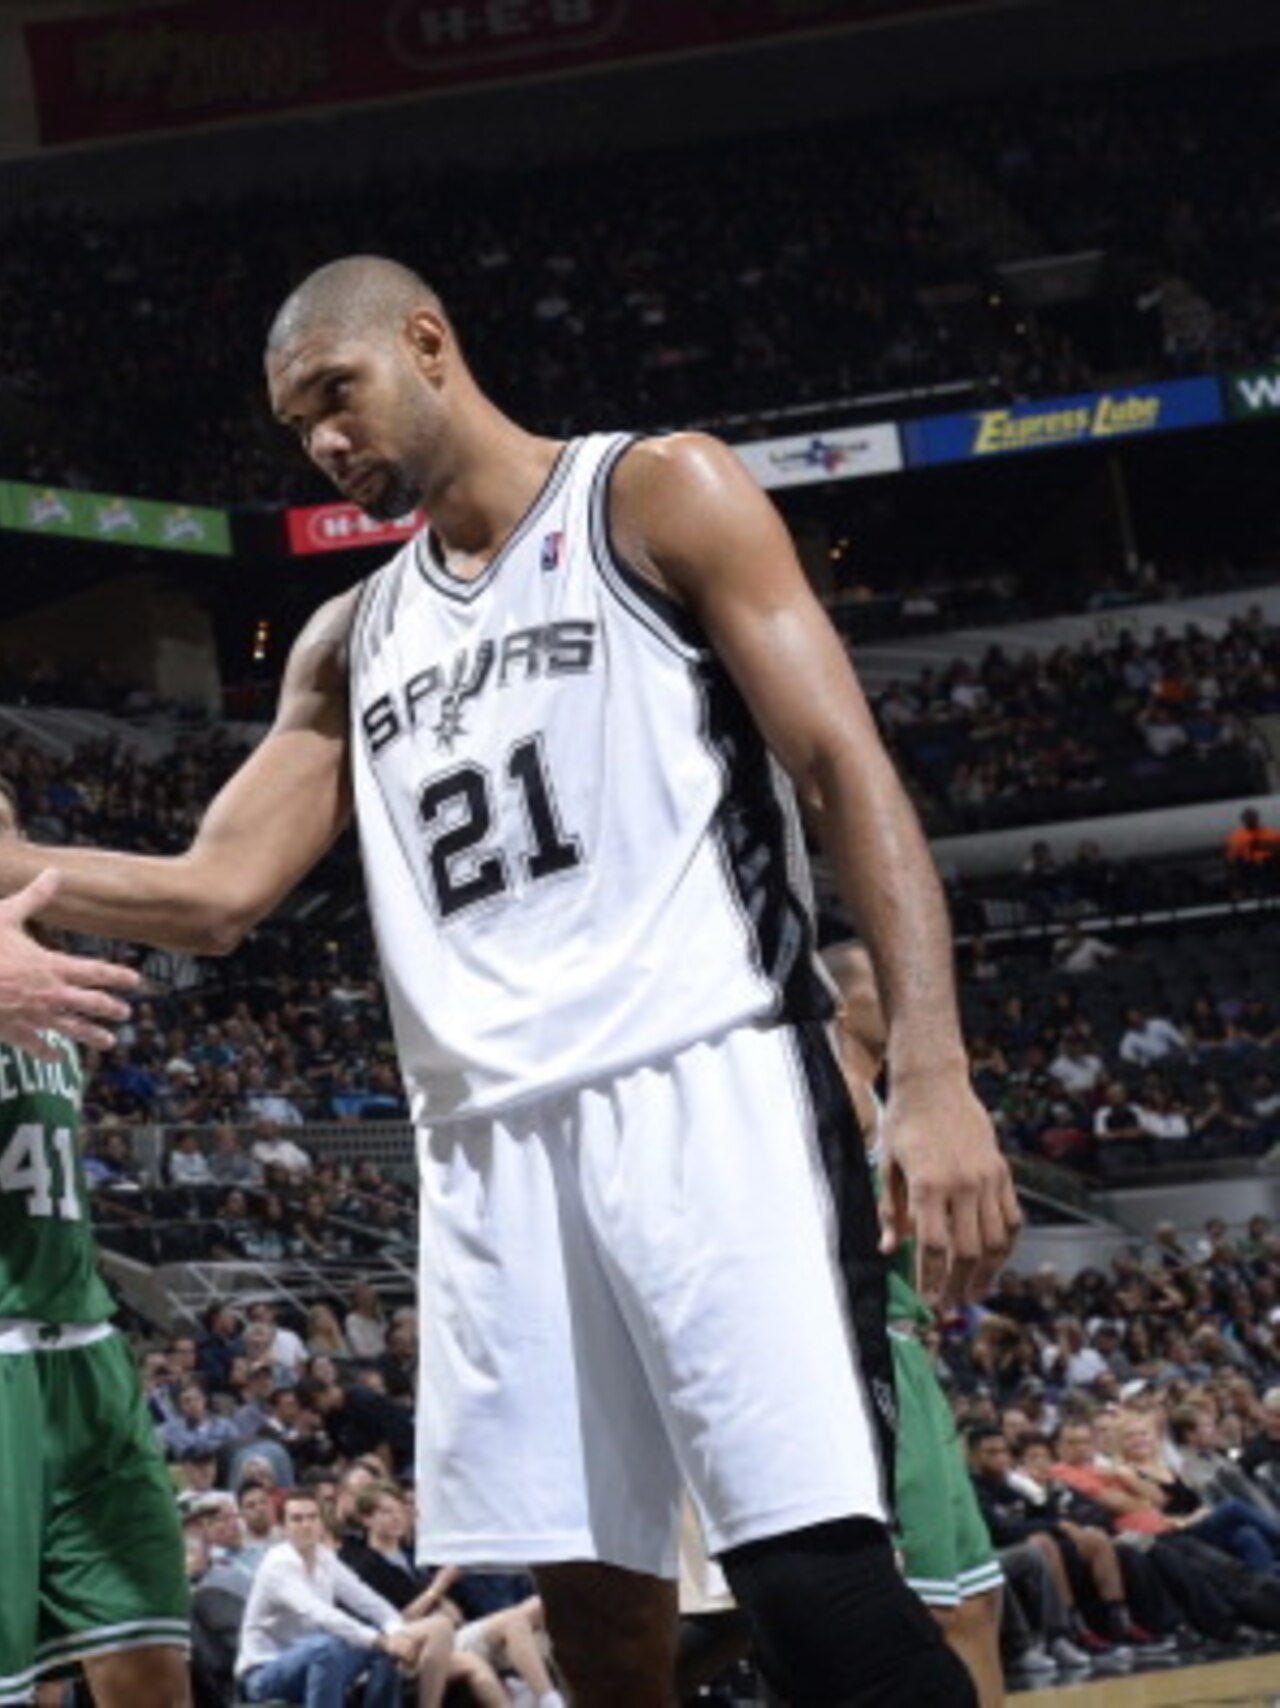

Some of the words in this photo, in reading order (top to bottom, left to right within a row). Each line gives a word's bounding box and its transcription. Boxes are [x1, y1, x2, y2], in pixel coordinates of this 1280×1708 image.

[972, 409, 1091, 455] Express
[1090, 394, 1161, 437] Lube
[361, 620, 597, 754] SPURS
[419, 731, 582, 917] 21
